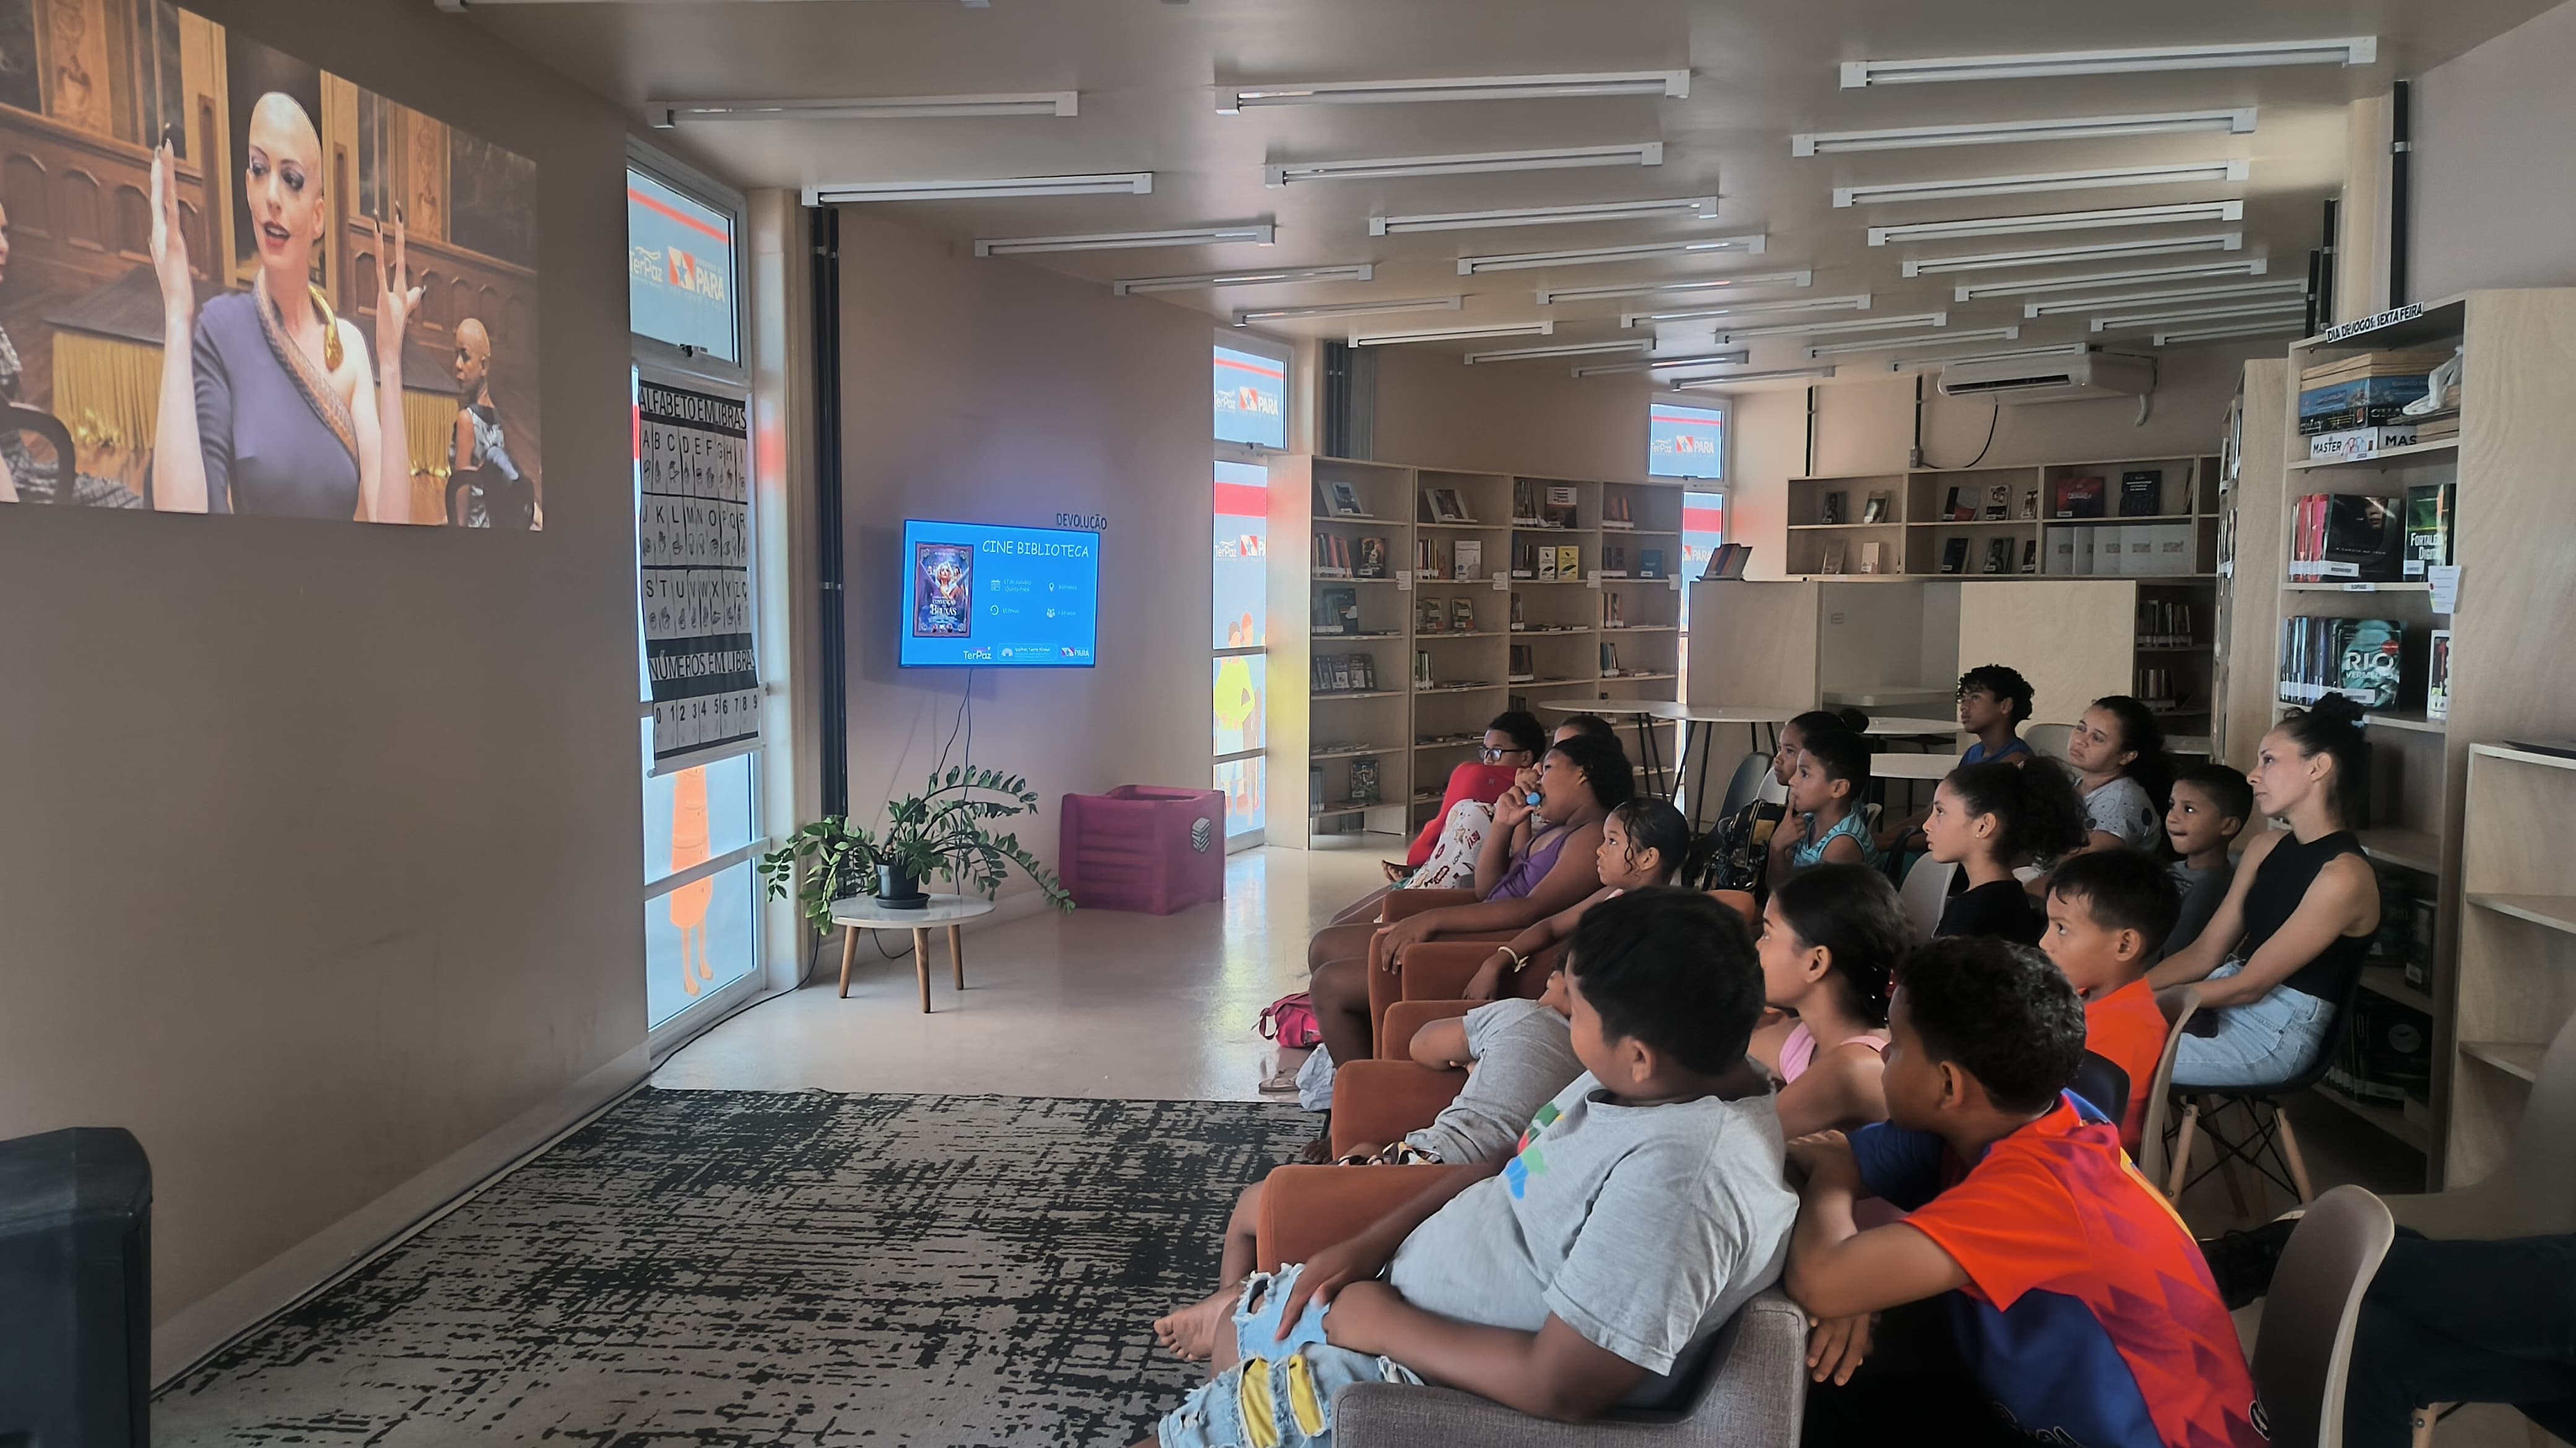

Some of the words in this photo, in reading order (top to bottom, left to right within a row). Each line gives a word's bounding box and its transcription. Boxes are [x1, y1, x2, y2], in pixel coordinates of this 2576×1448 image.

[2327, 328, 2340, 341] DIA
[2377, 311, 2398, 326] SEXTA
[2400, 303, 2422, 320] FEIRA
[640, 387, 695, 419] ALFABETO
[698, 399, 713, 422] EM
[714, 404, 747, 430] LIBRAS
[2313, 441, 2342, 455] MASTER
[1056, 513, 1107, 531] DEVOLUÇÃO
[982, 540, 1014, 555] CINE
[1017, 541, 1089, 558] BIBLIOTECA
[1214, 545, 1237, 557] TerPaz
[963, 650, 991, 660] TerPaz
[2346, 652, 2394, 671] RIO
[650, 650, 705, 680] NÚMEROS
[709, 652, 725, 674] EM
[728, 650, 756, 673] LIBRAS
